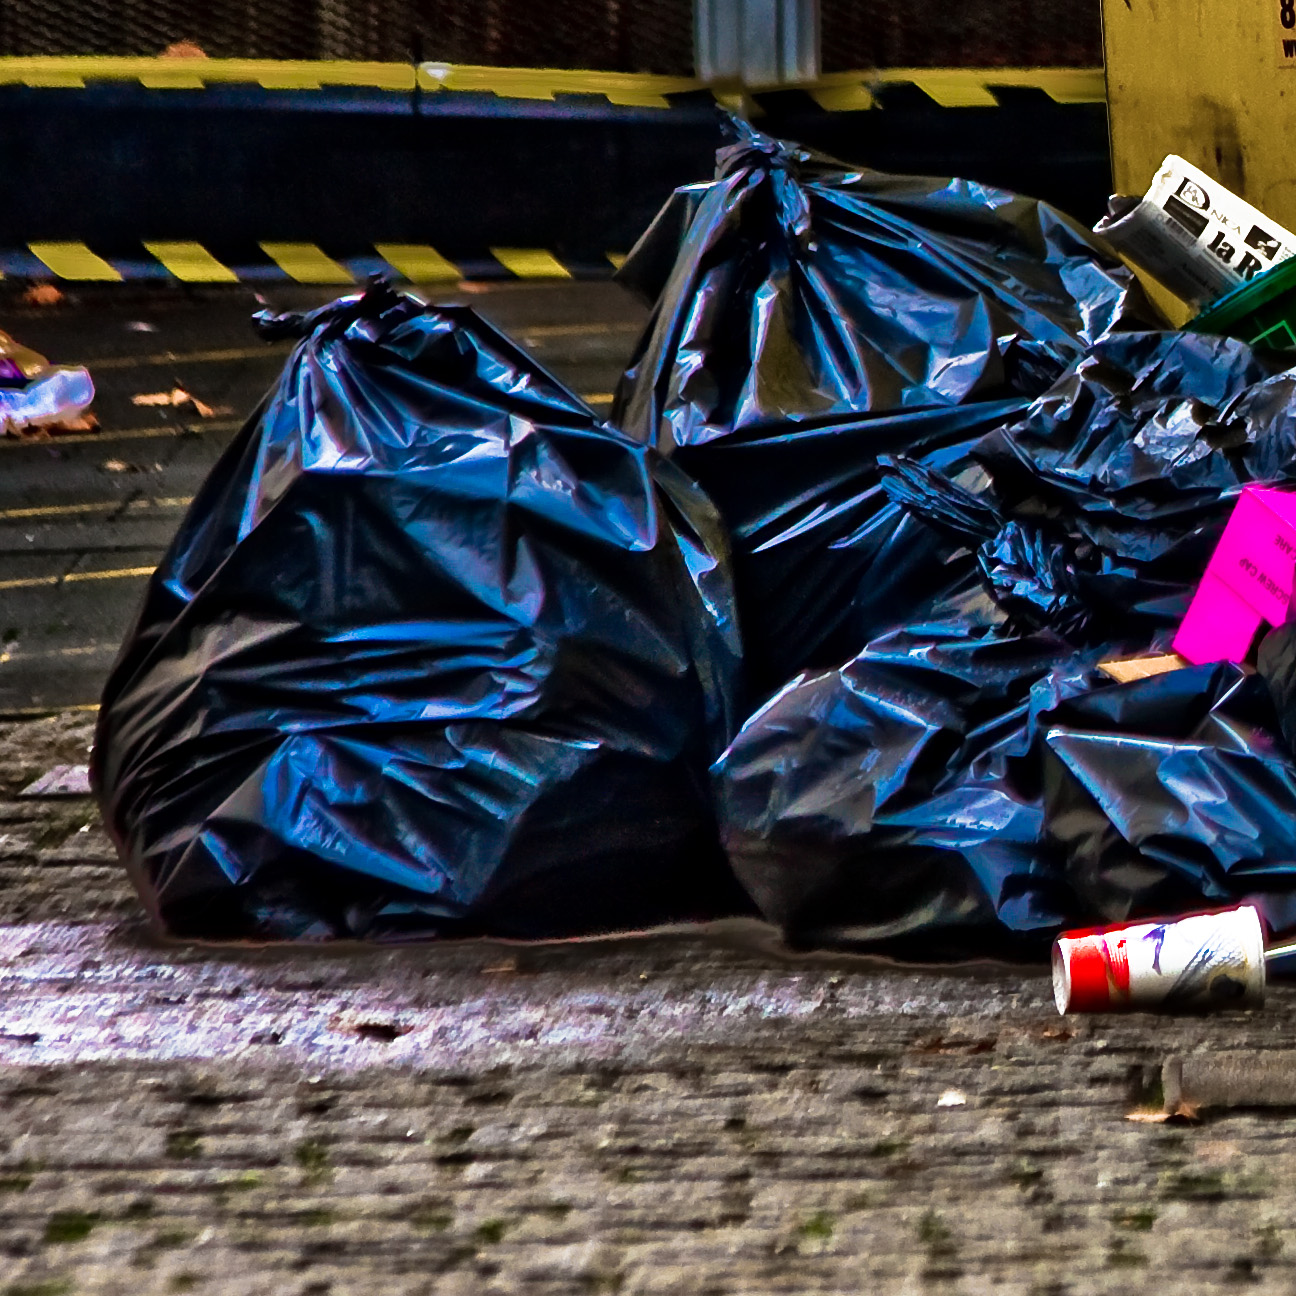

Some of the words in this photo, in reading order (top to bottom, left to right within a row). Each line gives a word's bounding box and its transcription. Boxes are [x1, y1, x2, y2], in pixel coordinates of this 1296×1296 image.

[1207, 231, 1232, 264] la
[1239, 558, 1258, 577] CAP
[1257, 572, 1290, 605] SCREW
